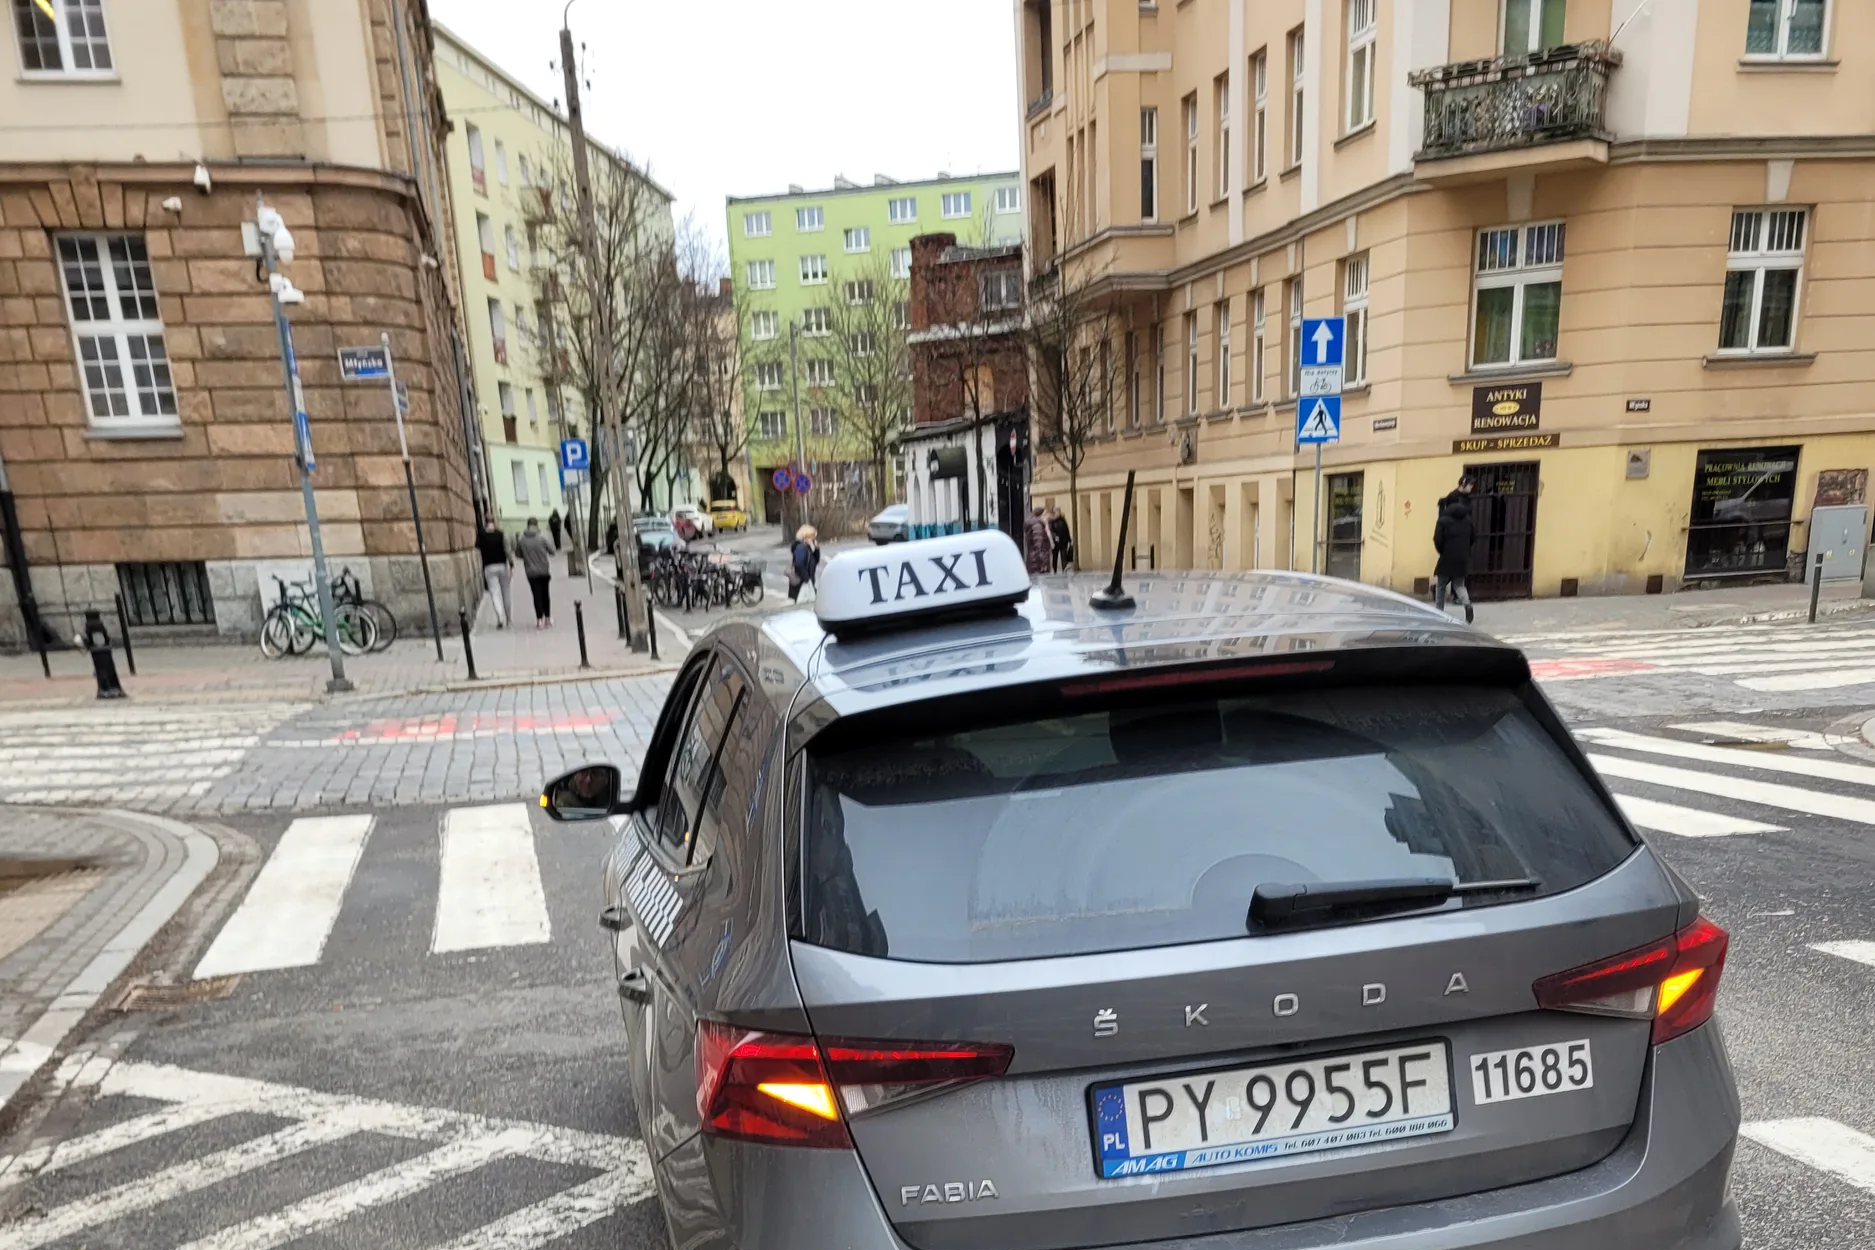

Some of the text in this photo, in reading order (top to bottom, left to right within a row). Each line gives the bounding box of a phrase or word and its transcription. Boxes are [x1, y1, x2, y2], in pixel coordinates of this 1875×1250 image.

[1485, 388, 1527, 402] ANTYKI
[1474, 413, 1536, 428] RENOWACJA
[566, 443, 582, 467] P
[1460, 440, 1487, 451] SKUP
[858, 548, 993, 605] TAXI
[1093, 971, 1469, 1037] ŠKODA
[1475, 1043, 1588, 1099] 11685
[1138, 1051, 1431, 1149] PY 9955F
[1103, 1132, 1126, 1152] PL
[1112, 1153, 1180, 1176] AMAG
[1193, 1147, 1232, 1165] AUTO
[1234, 1143, 1278, 1159] KOMIS
[900, 1179, 1000, 1206] FABIA
